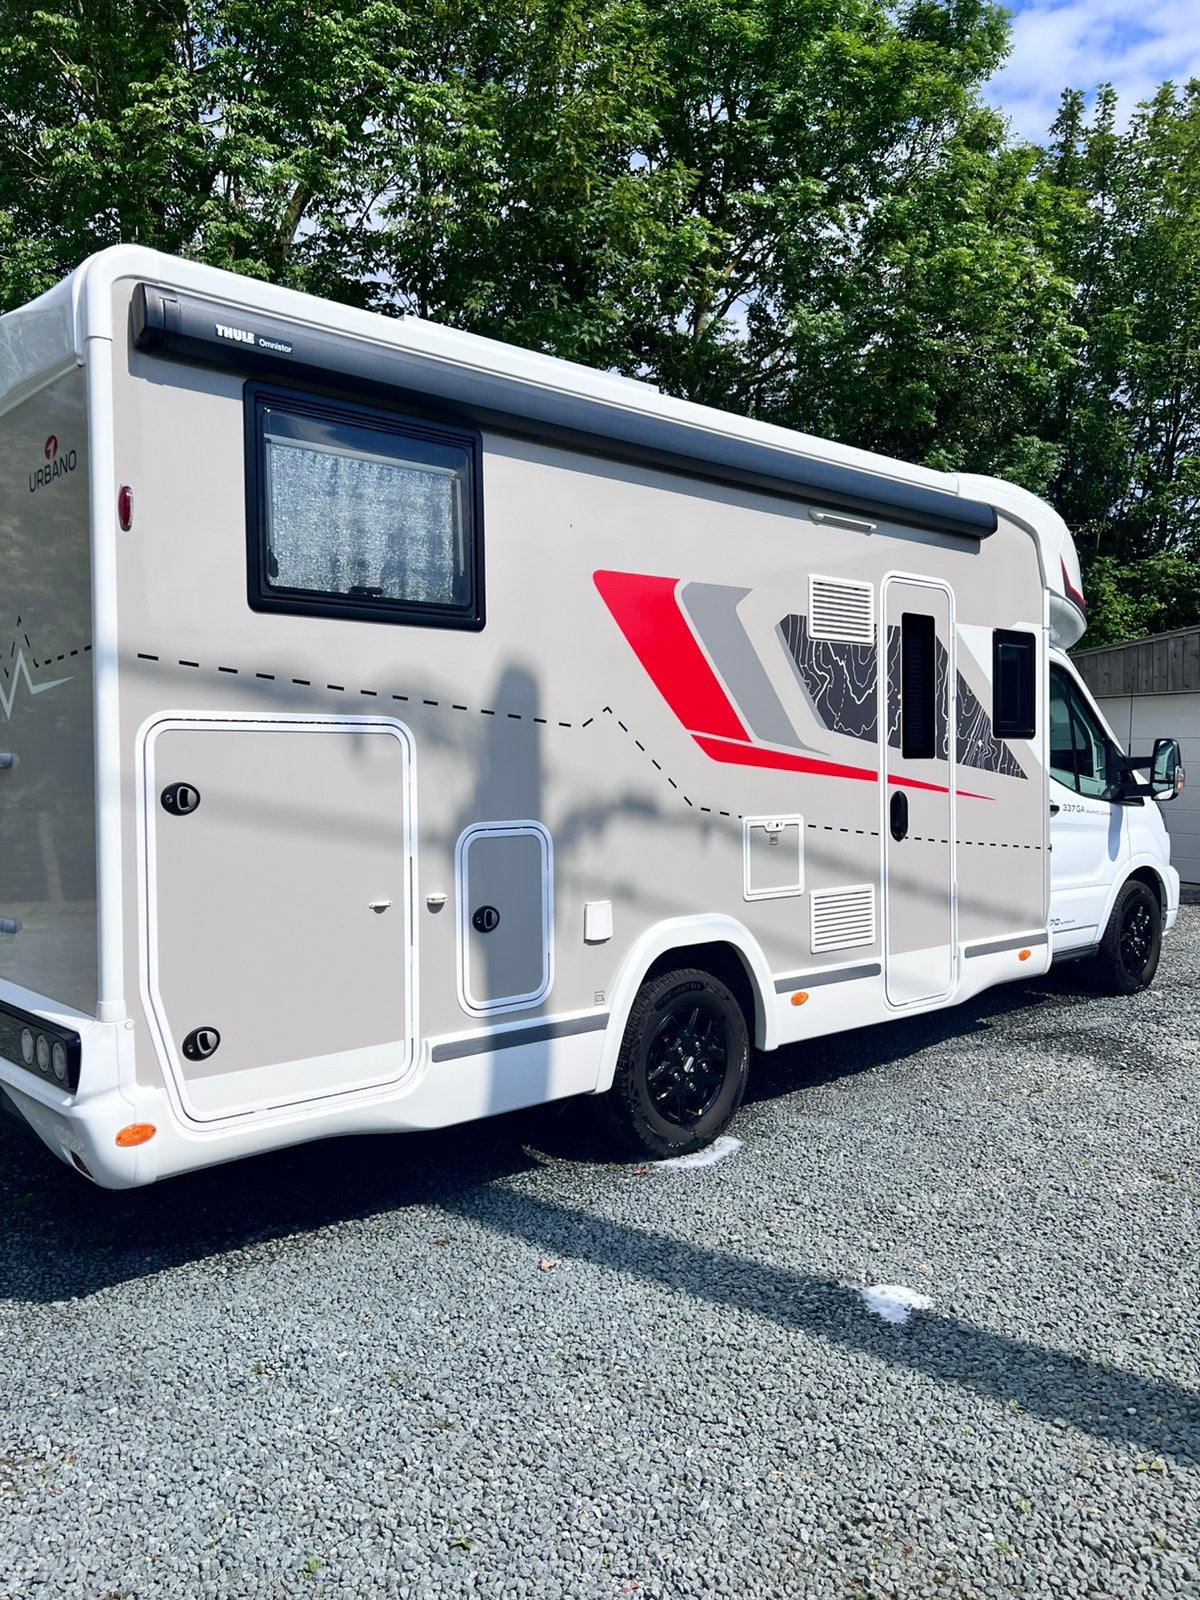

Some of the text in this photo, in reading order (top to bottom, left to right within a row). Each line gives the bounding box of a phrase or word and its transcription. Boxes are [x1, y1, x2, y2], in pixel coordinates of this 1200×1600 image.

[215, 323, 293, 354] THULE Omnistor
[29, 449, 77, 493] URBANO
